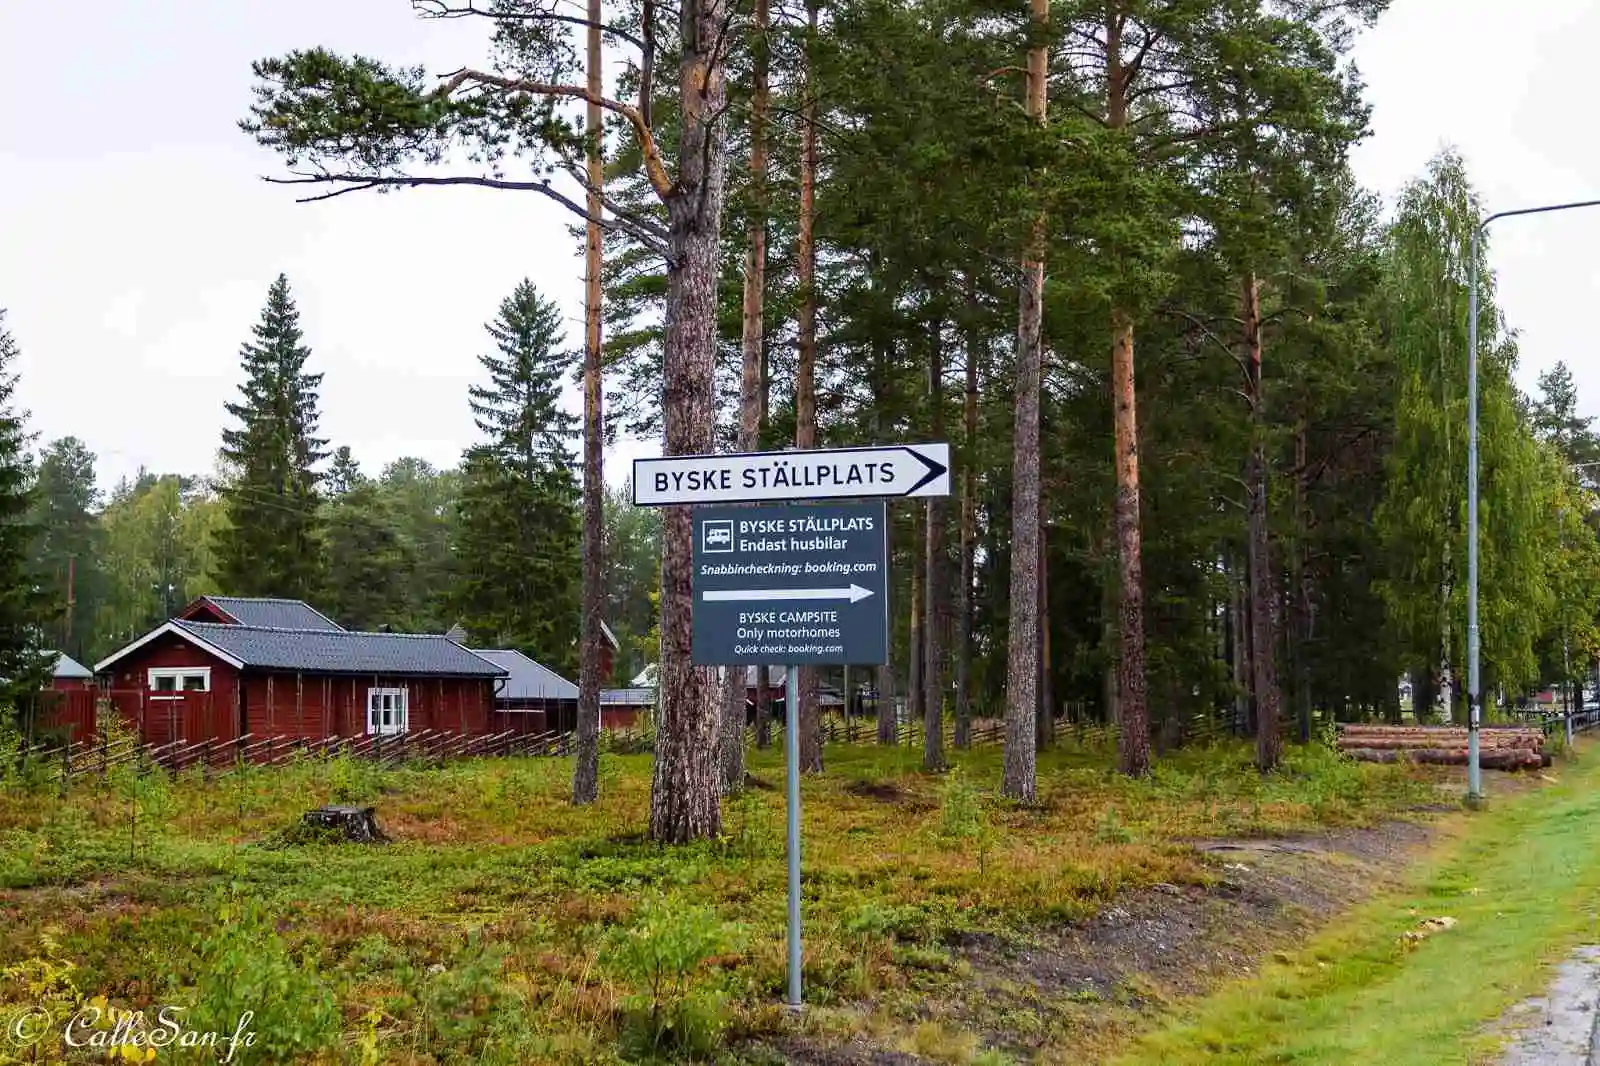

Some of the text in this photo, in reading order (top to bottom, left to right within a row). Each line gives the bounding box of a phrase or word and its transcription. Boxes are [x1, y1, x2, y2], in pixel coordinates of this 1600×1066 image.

[655, 461, 895, 492] BYSKE STÄLLPLATS
[740, 515, 874, 534] BYSKE STÄLLPLATS
[740, 537, 848, 552] Endast husbilar
[700, 561, 877, 576] Snabbincheckning: booking.com
[739, 611, 838, 624] BYSKE CAMPSITE
[737, 626, 841, 640] Only motorhomes
[734, 644, 758, 655] Quick
[788, 643, 843, 655] booking.com
